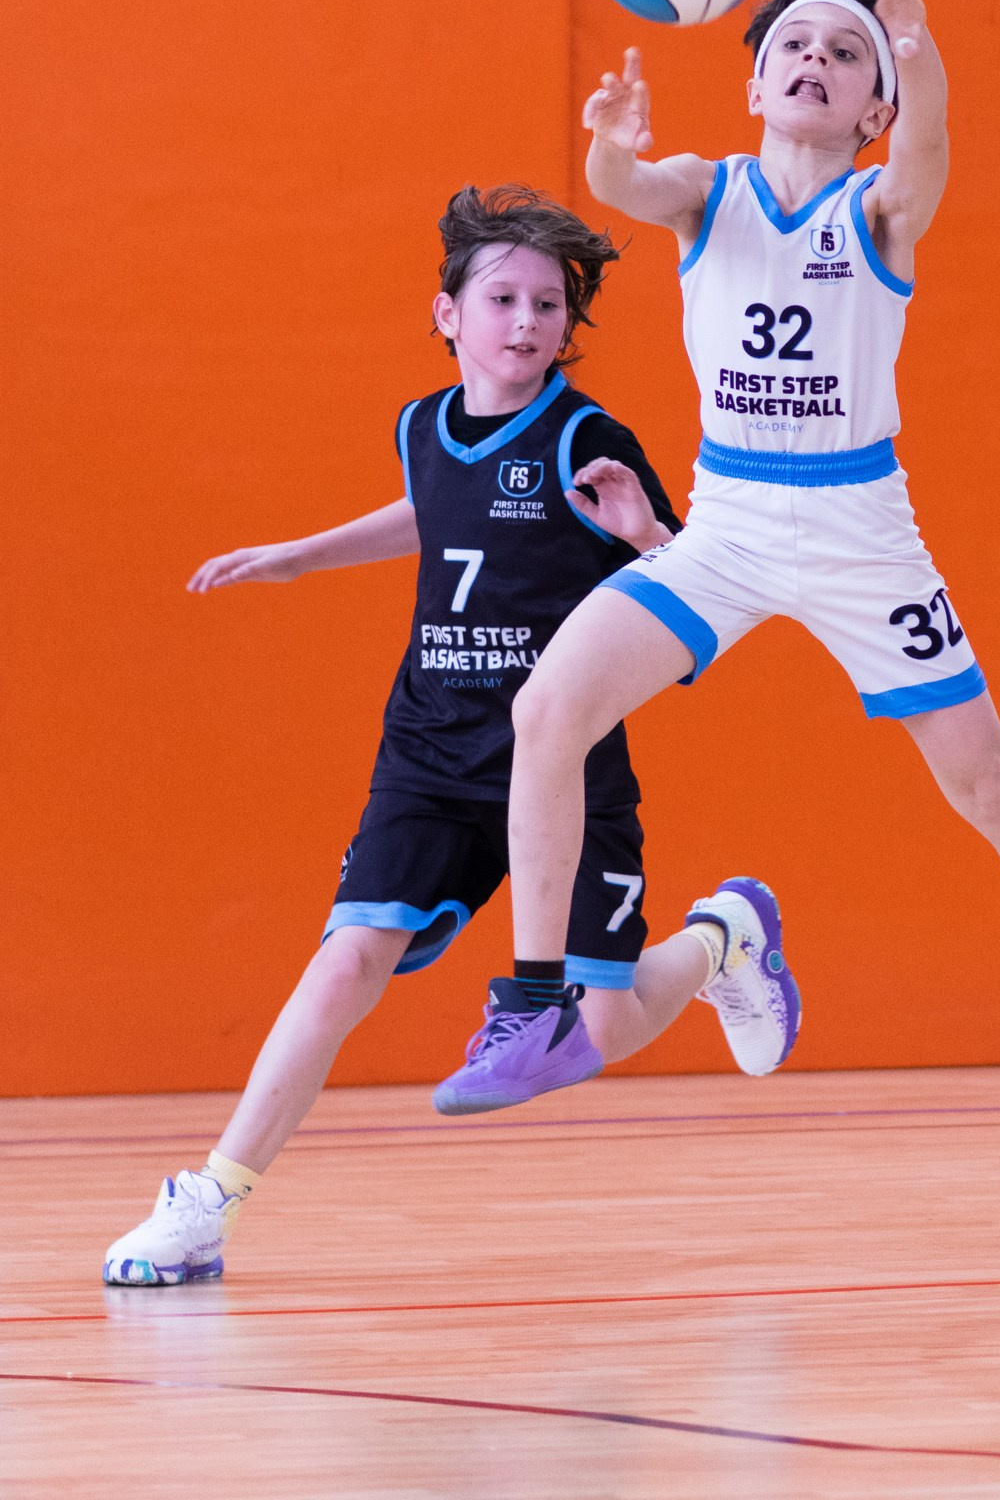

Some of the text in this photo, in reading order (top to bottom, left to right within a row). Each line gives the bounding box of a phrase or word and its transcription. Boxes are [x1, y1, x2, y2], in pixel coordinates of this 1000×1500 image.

[802, 270, 854, 279] BASKETBALL
[806, 261, 850, 271] FIRST STEP
[742, 303, 813, 361] 32
[719, 368, 839, 396] FIRST STEP
[714, 390, 846, 418] BASKETBALL
[749, 421, 804, 434] ACADEMY
[509, 466, 529, 489] FS
[489, 509, 548, 520] BASKETBALL
[493, 500, 544, 510] FIRST STEP
[443, 548, 484, 613] 7
[889, 588, 964, 661] 32
[472, 626, 532, 647] STEP
[443, 677, 503, 688] ACADEMY
[602, 871, 643, 933] 7
